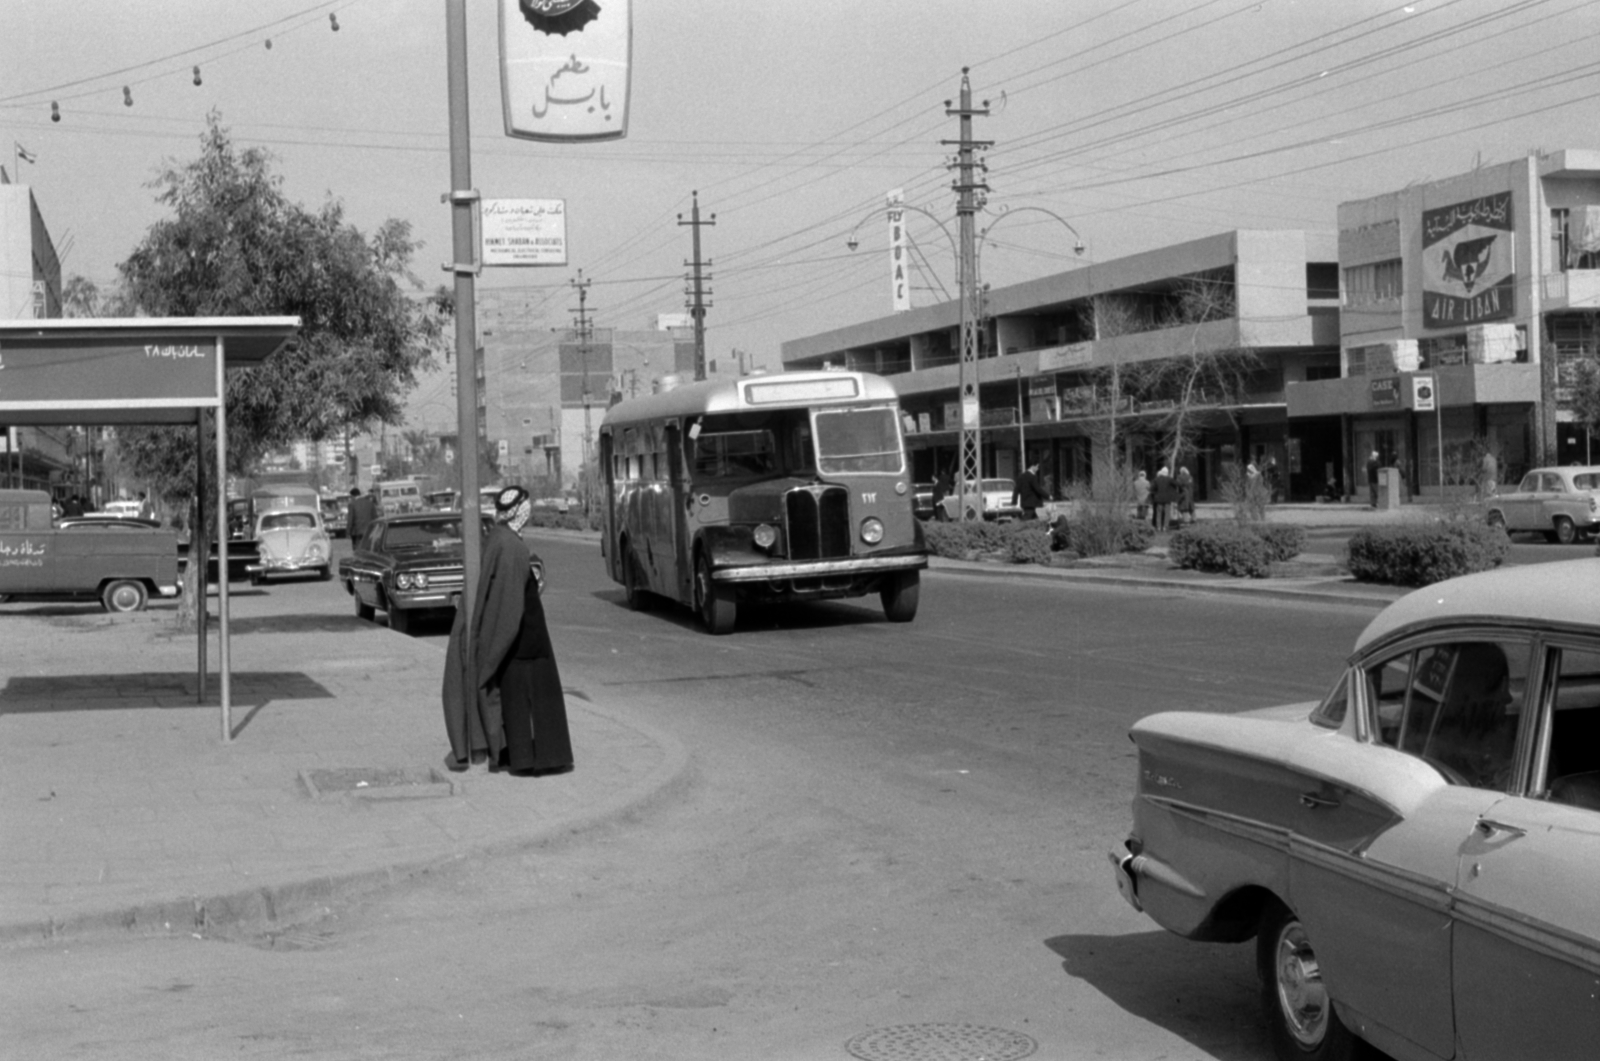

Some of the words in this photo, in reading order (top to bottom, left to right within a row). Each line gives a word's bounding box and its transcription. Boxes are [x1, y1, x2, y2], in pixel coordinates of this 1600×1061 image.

[550, 53, 589, 88] مطعم
[532, 84, 612, 121] بابل
[1431, 298, 1454, 320] AIR
[1463, 288, 1500, 321] LIBAN
[178, 345, 205, 358] سلمان
[1372, 380, 1393, 391] CASE
